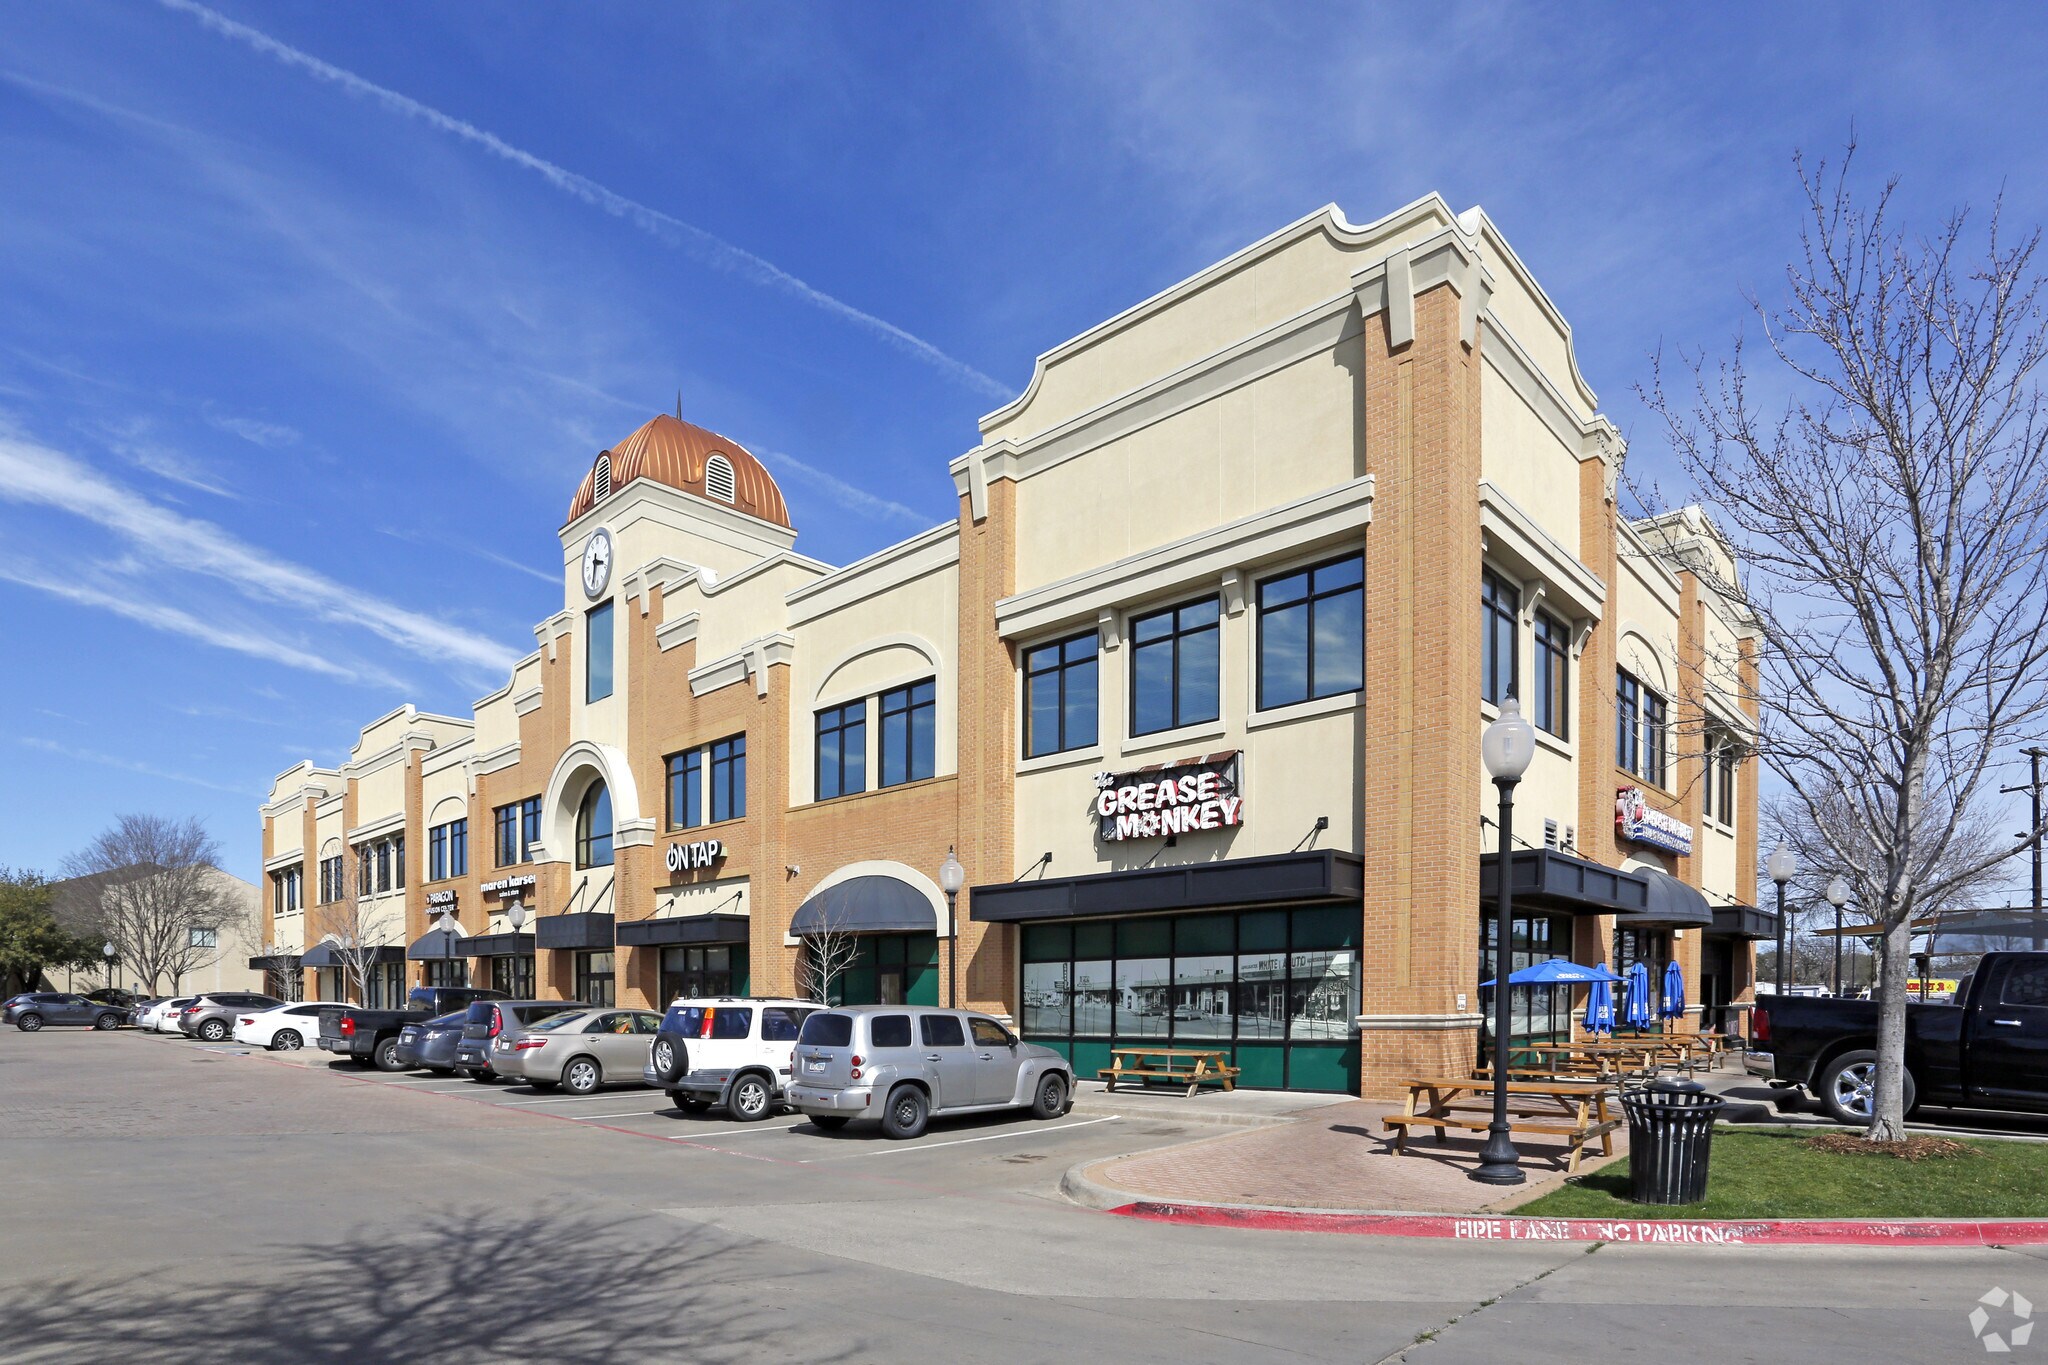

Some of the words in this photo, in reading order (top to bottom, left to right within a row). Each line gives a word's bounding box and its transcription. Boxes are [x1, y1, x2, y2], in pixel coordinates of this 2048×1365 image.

[1097, 771, 1219, 816] GREASE
[1116, 797, 1241, 840] MONKEY
[666, 843, 689, 872] ON
[690, 840, 718, 868] TAP
[430, 889, 454, 904] PARAGON
[480, 879, 508, 892] maren
[1455, 1220, 1502, 1239] FIRE
[1510, 1220, 1569, 1240] LANE
[1598, 1222, 1631, 1241] NO
